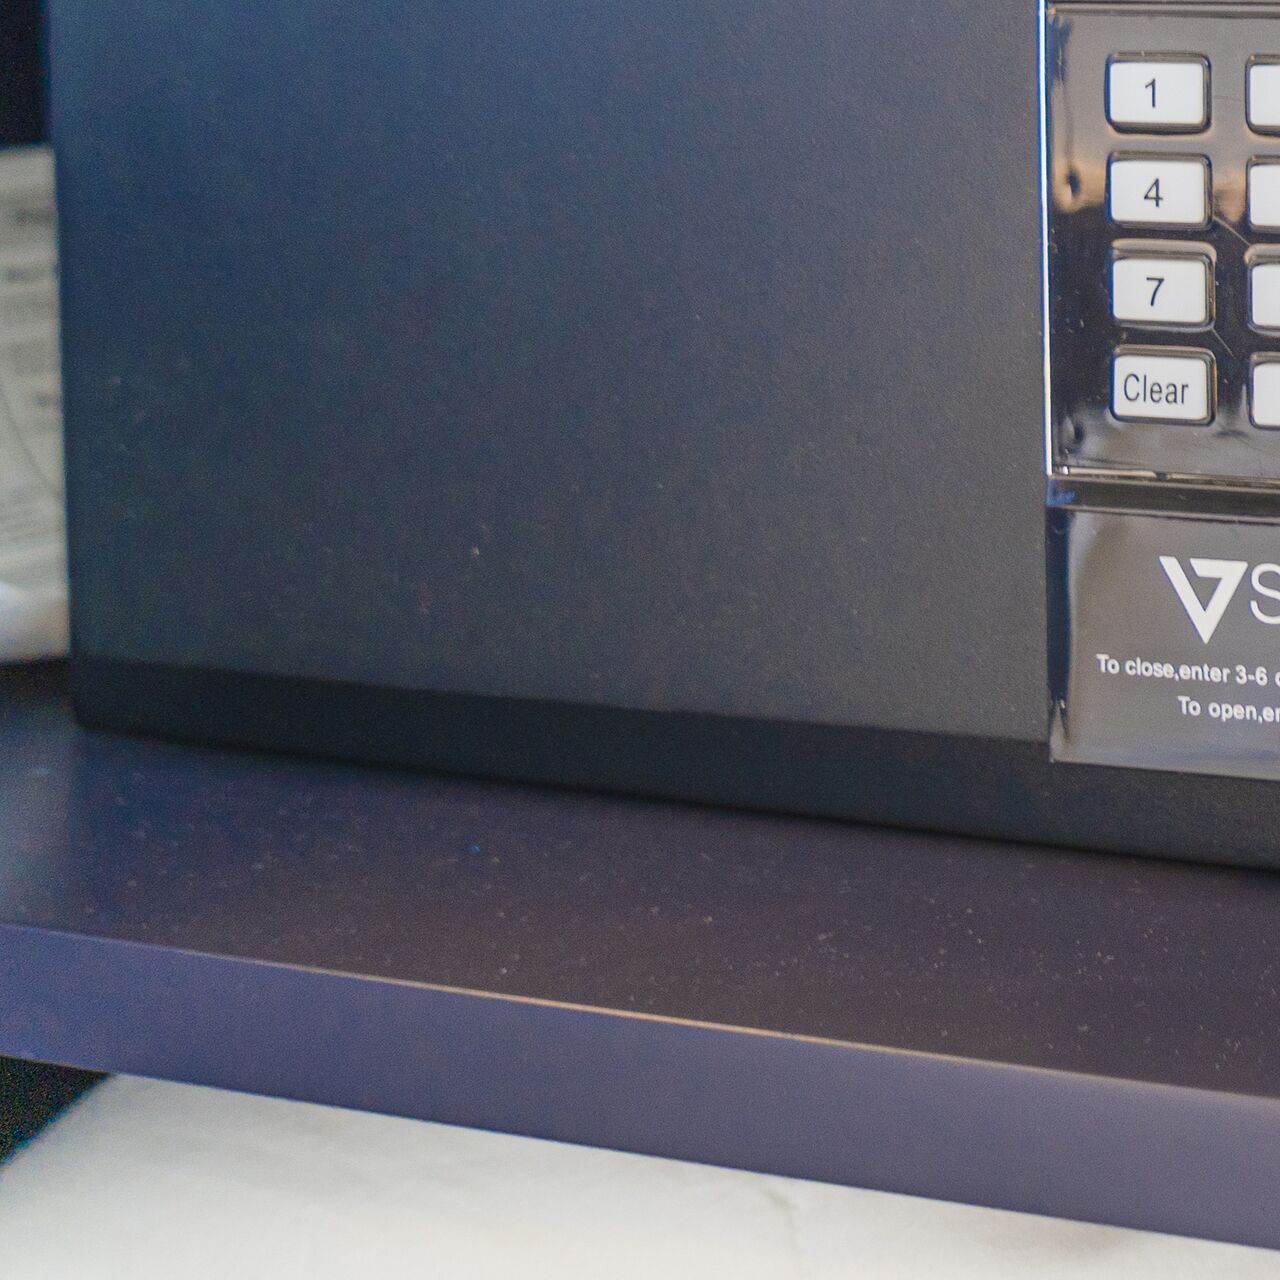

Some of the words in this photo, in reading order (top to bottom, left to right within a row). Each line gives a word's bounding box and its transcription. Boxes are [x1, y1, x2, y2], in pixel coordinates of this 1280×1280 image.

[1144, 78, 1156, 108] 1
[1143, 178, 1164, 208] 4
[1146, 276, 1165, 307] 7
[1123, 373, 1189, 404] Clear
[1096, 653, 1120, 674] To
[1235, 664, 1268, 686] 3-6
[1177, 695, 1201, 716] To
